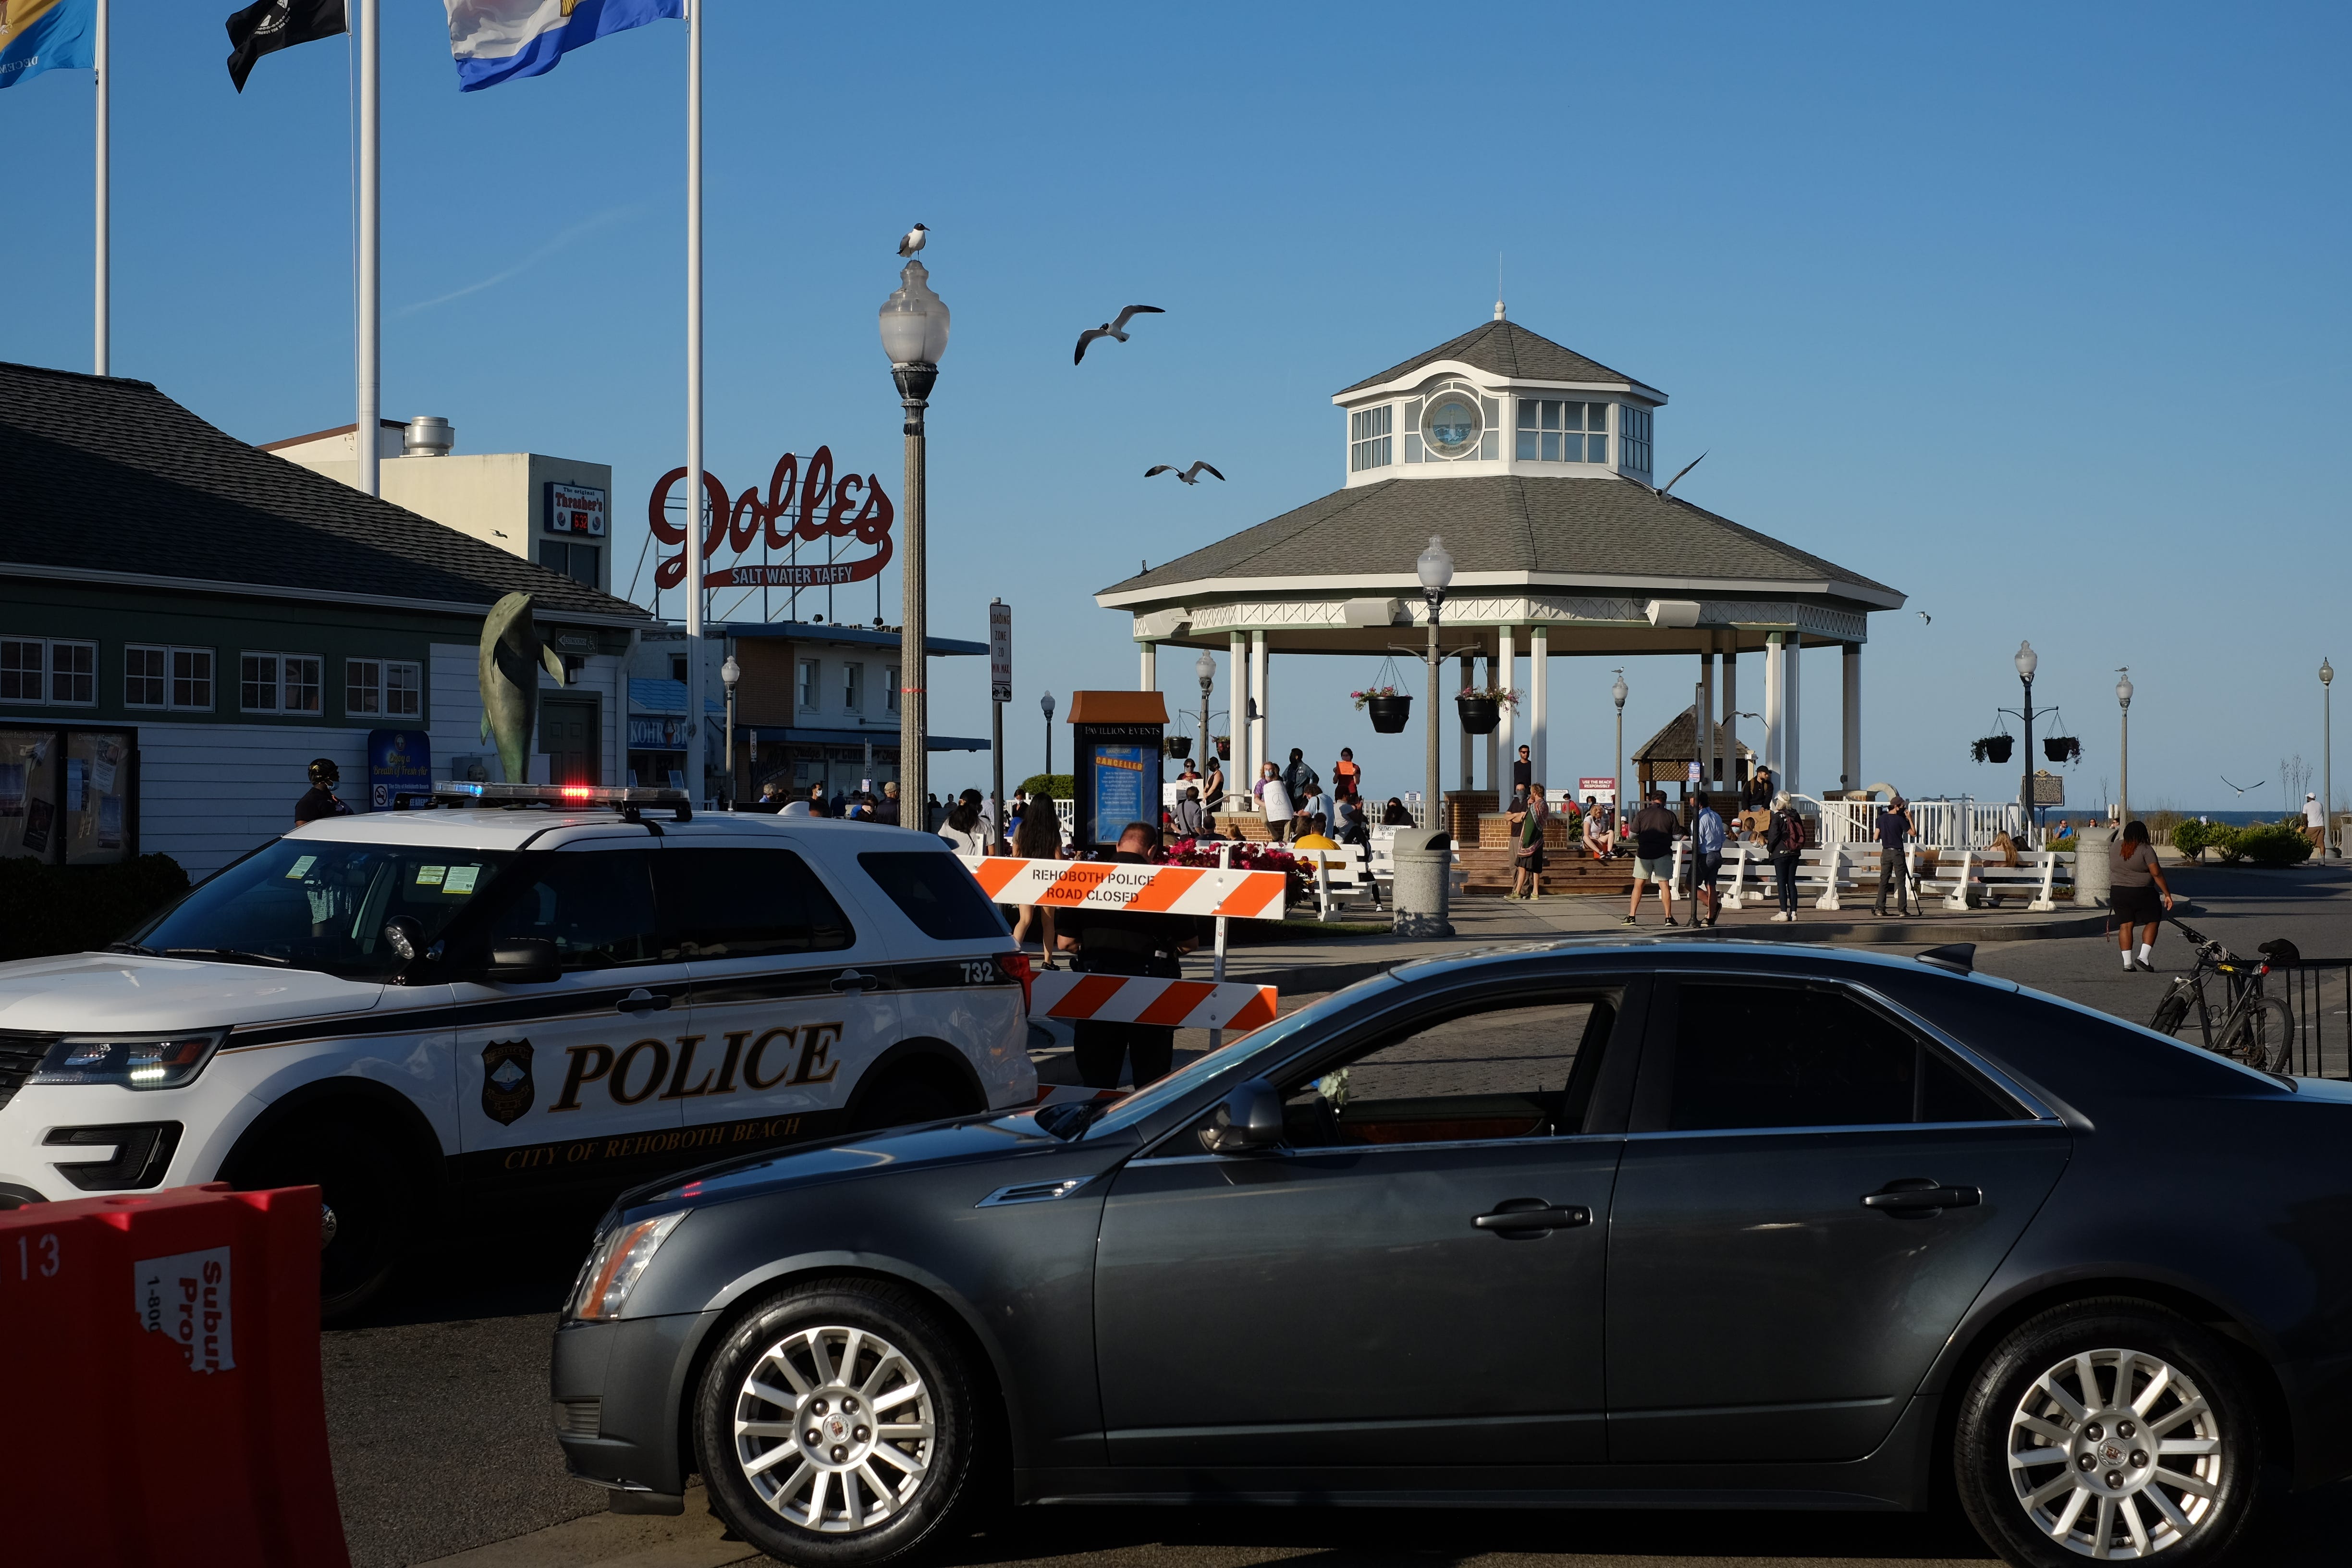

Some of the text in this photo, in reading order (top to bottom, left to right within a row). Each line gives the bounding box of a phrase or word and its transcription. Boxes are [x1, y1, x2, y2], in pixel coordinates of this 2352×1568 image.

[1465, 401, 1475, 414] BEACH
[555, 492, 603, 512] Thrasher's
[732, 566, 853, 585] SALT WATER TAFFY
[991, 613, 1010, 625] LOADING
[995, 631, 1006, 641] ZONE
[998, 647, 1004, 657] 20
[630, 721, 665, 744] KOHR
[390, 753, 405, 765] Enjoy
[1095, 757, 1143, 771] CANCELLED
[373, 765, 428, 778] Breath of Fresh Air
[1033, 869, 1155, 886] REHOBOTH POLICE
[1046, 887, 1139, 903] ROAD CLOSED
[959, 961, 994, 983] 732
[548, 1021, 844, 1114] POLICE
[504, 1117, 802, 1171] CITY OF REHOBOTH BEACH
